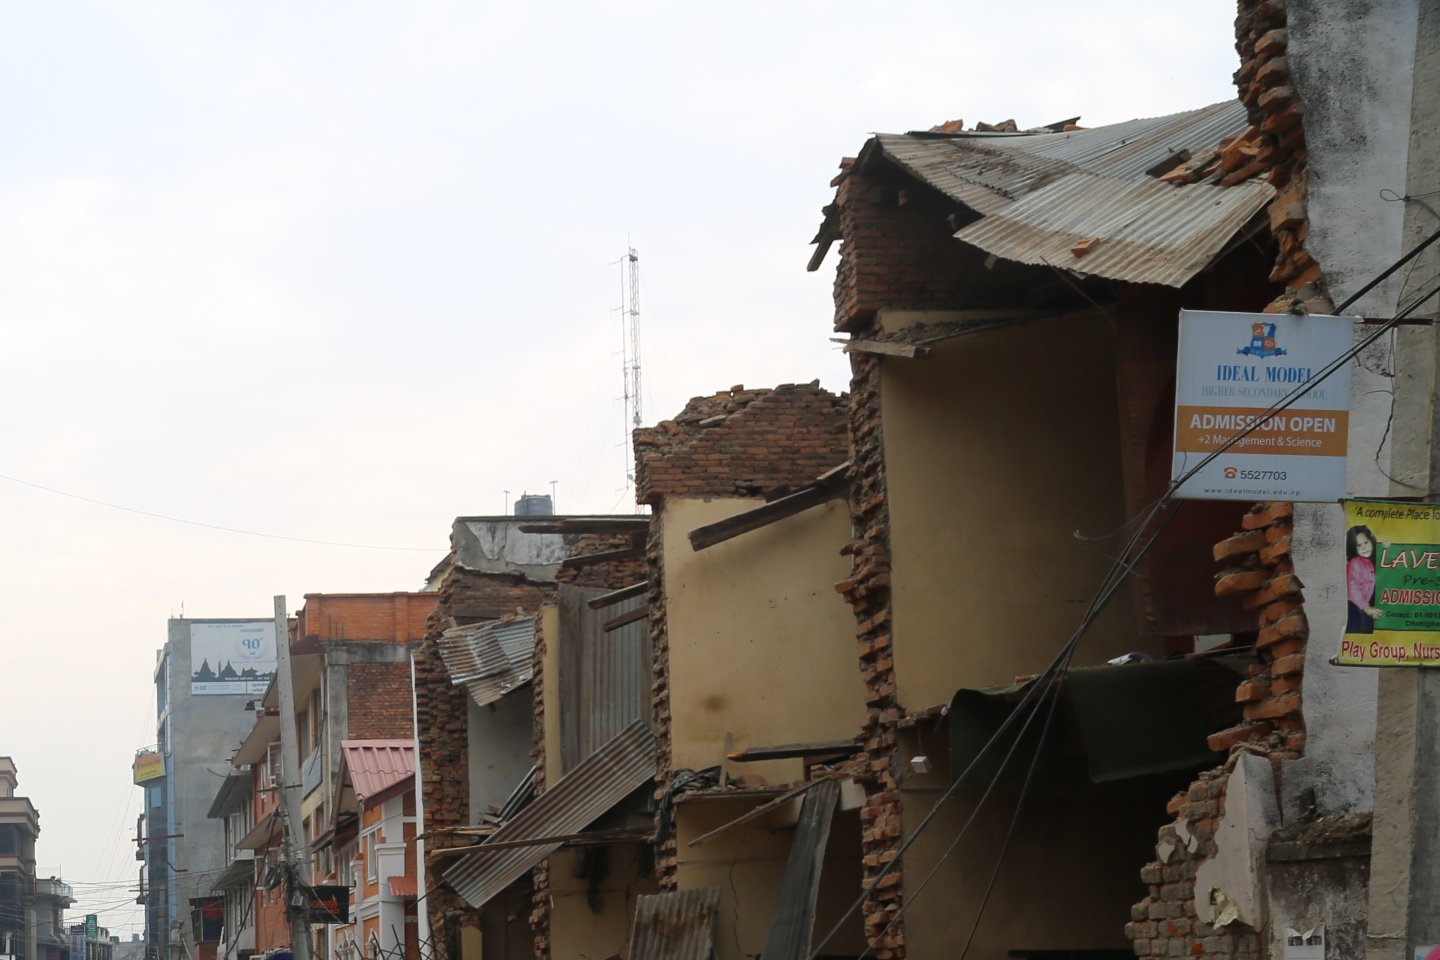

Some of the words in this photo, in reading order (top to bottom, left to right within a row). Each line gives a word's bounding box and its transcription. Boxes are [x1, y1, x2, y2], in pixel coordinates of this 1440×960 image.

[1216, 364, 1260, 383] IDEAL
[1264, 366, 1316, 384] MODEL
[1201, 385, 1236, 398] HIGHER
[1237, 386, 1290, 400] SECONDARY
[1290, 387, 1327, 400] SCHOOL
[1189, 413, 1287, 432] ADMISSION
[1290, 416, 1336, 433] OPEN
[1197, 435, 1211, 445] +2
[1212, 435, 1276, 449] Management
[1277, 437, 1285, 446] &
[1286, 436, 1323, 449] Science
[1240, 469, 1288, 481] 5527703
[1203, 488, 1301, 497] www.idealmodel.edu.np
[1364, 508, 1405, 521] complete
[1405, 509, 1430, 520] Place
[1386, 610, 1412, 619] Contact:
[1342, 640, 1366, 661] Play
[1369, 641, 1410, 662] Group,
